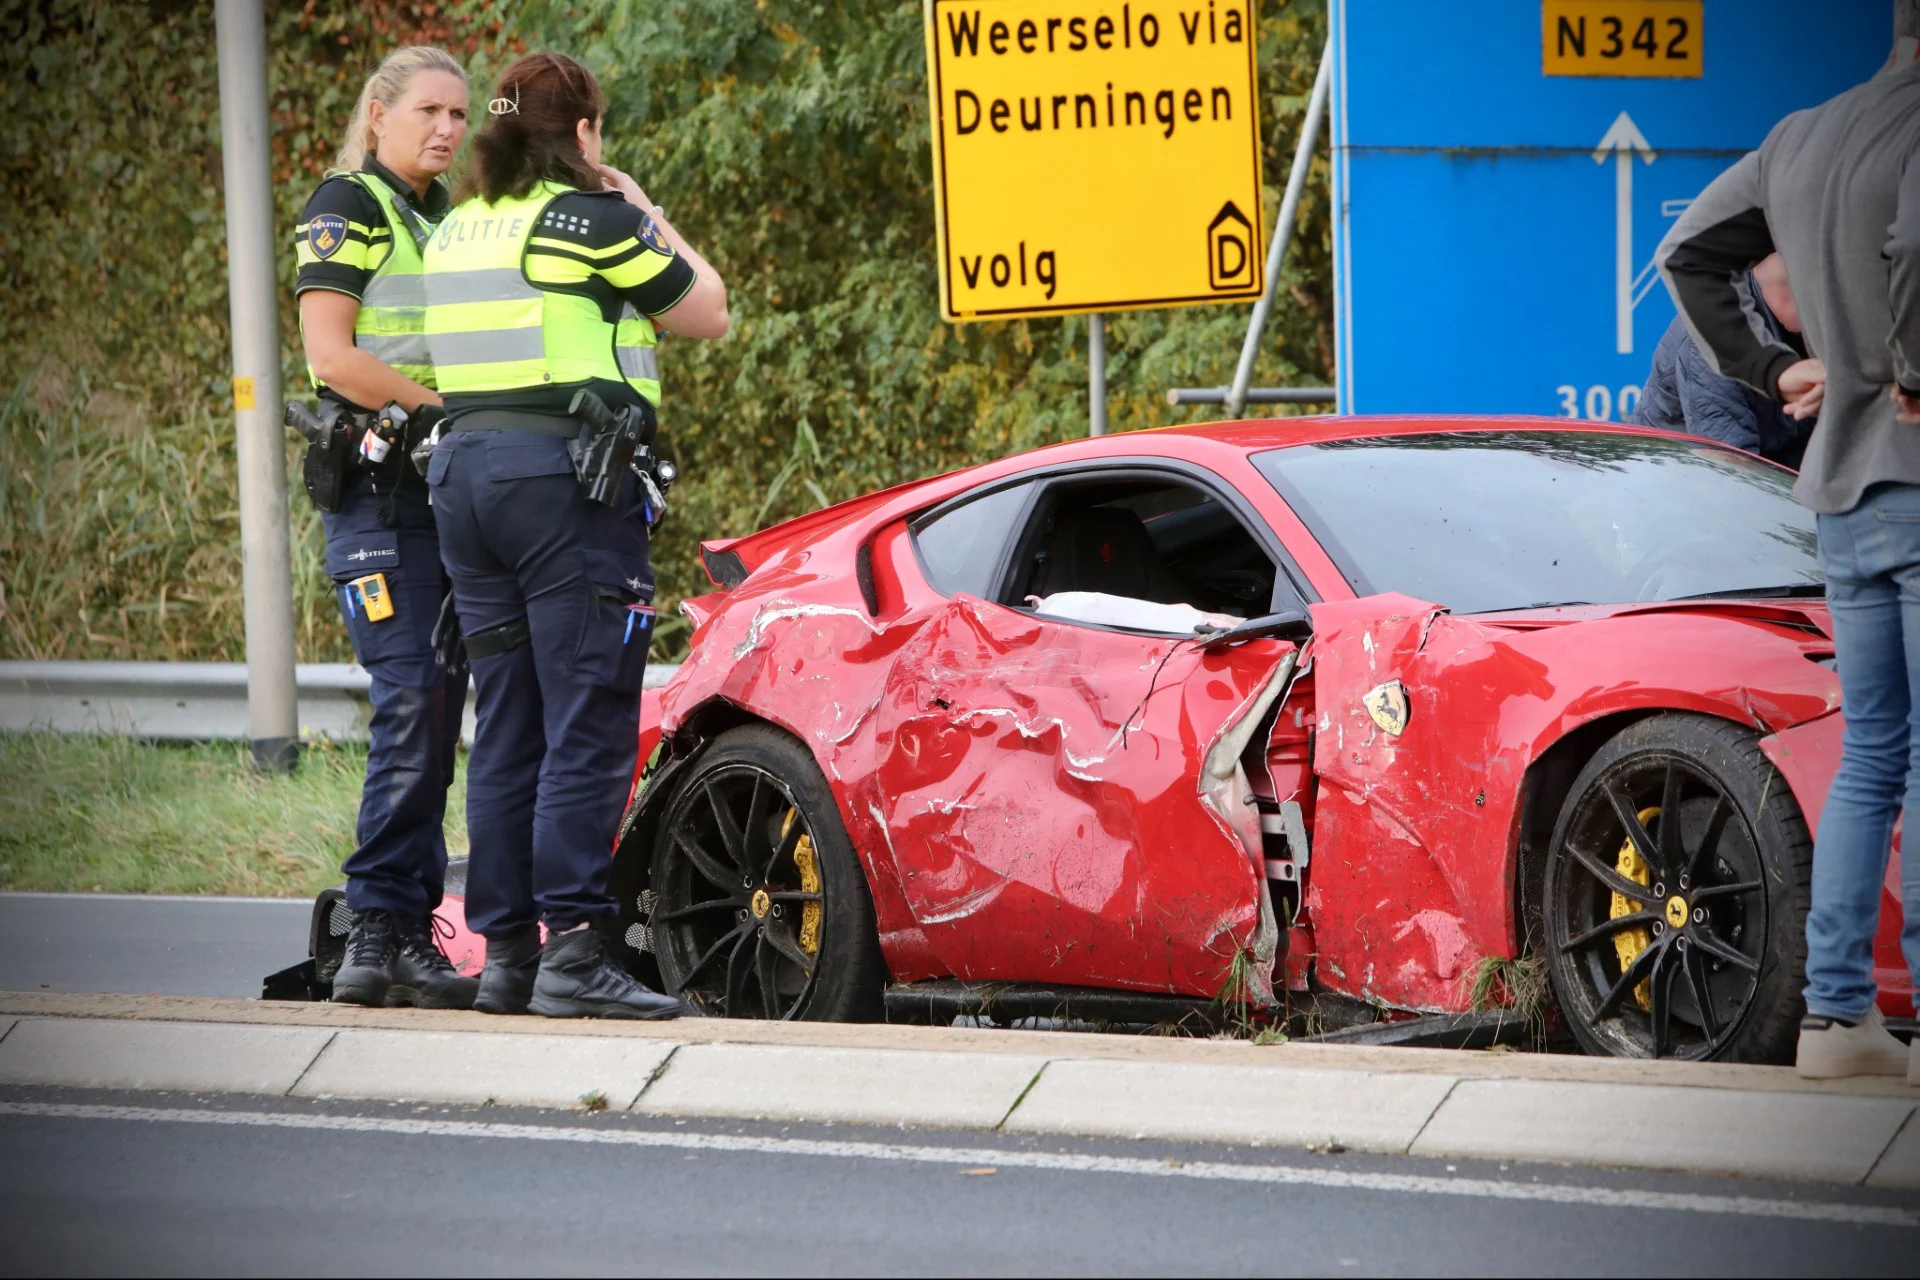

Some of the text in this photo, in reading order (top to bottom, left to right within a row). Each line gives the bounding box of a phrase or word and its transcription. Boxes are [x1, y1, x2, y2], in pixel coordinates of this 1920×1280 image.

[947, 1, 1243, 57] Weerselo via
[954, 82, 1232, 139] Deurningen
[959, 240, 1057, 300] volg
[1217, 234, 1247, 279] D
